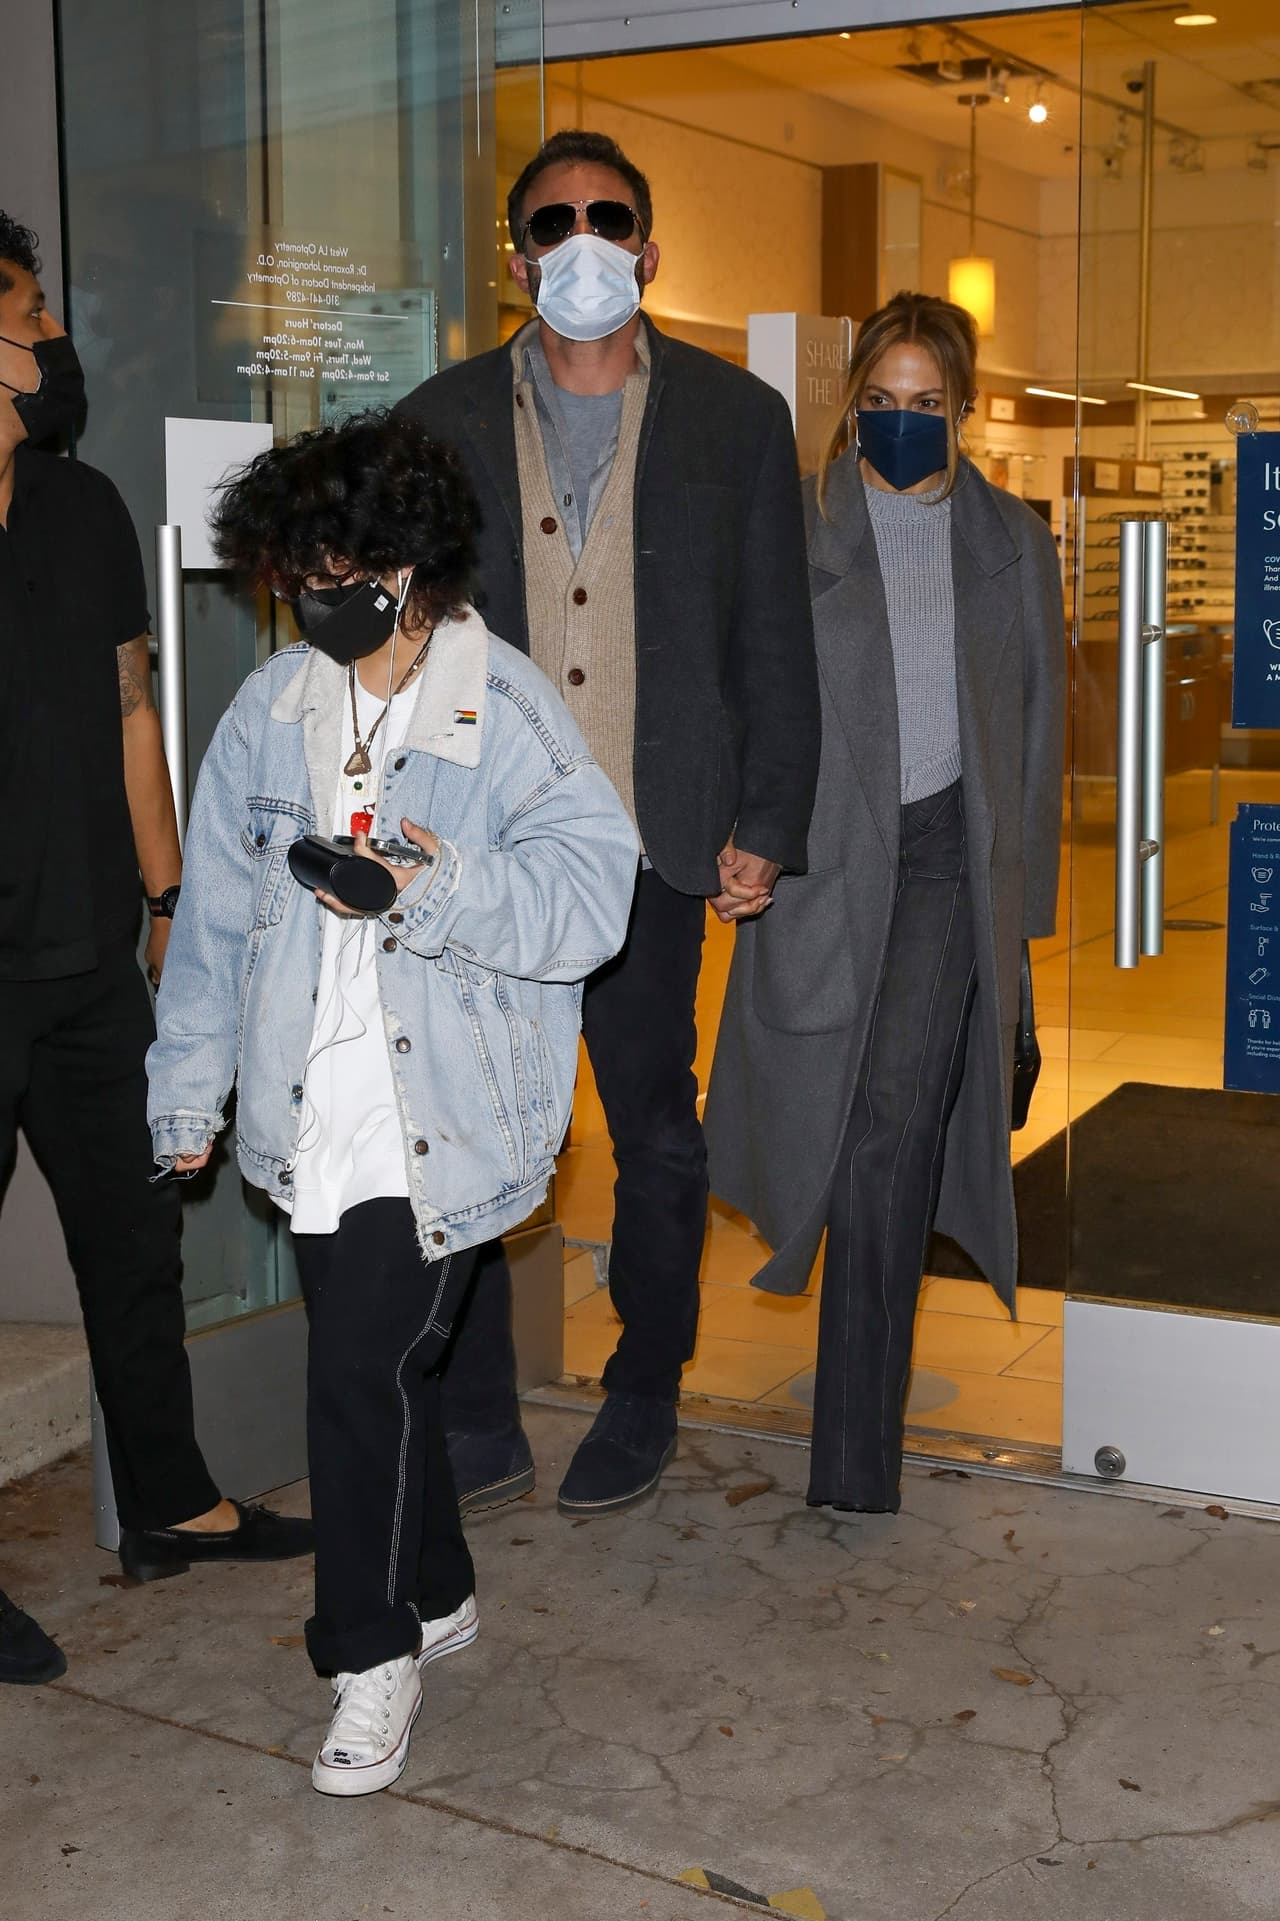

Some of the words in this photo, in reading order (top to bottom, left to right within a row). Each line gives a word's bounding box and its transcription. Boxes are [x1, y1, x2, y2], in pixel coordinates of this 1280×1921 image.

[808, 376, 832, 405] THE
[1264, 574, 1279, 582] And
[1266, 673, 1273, 681] A
